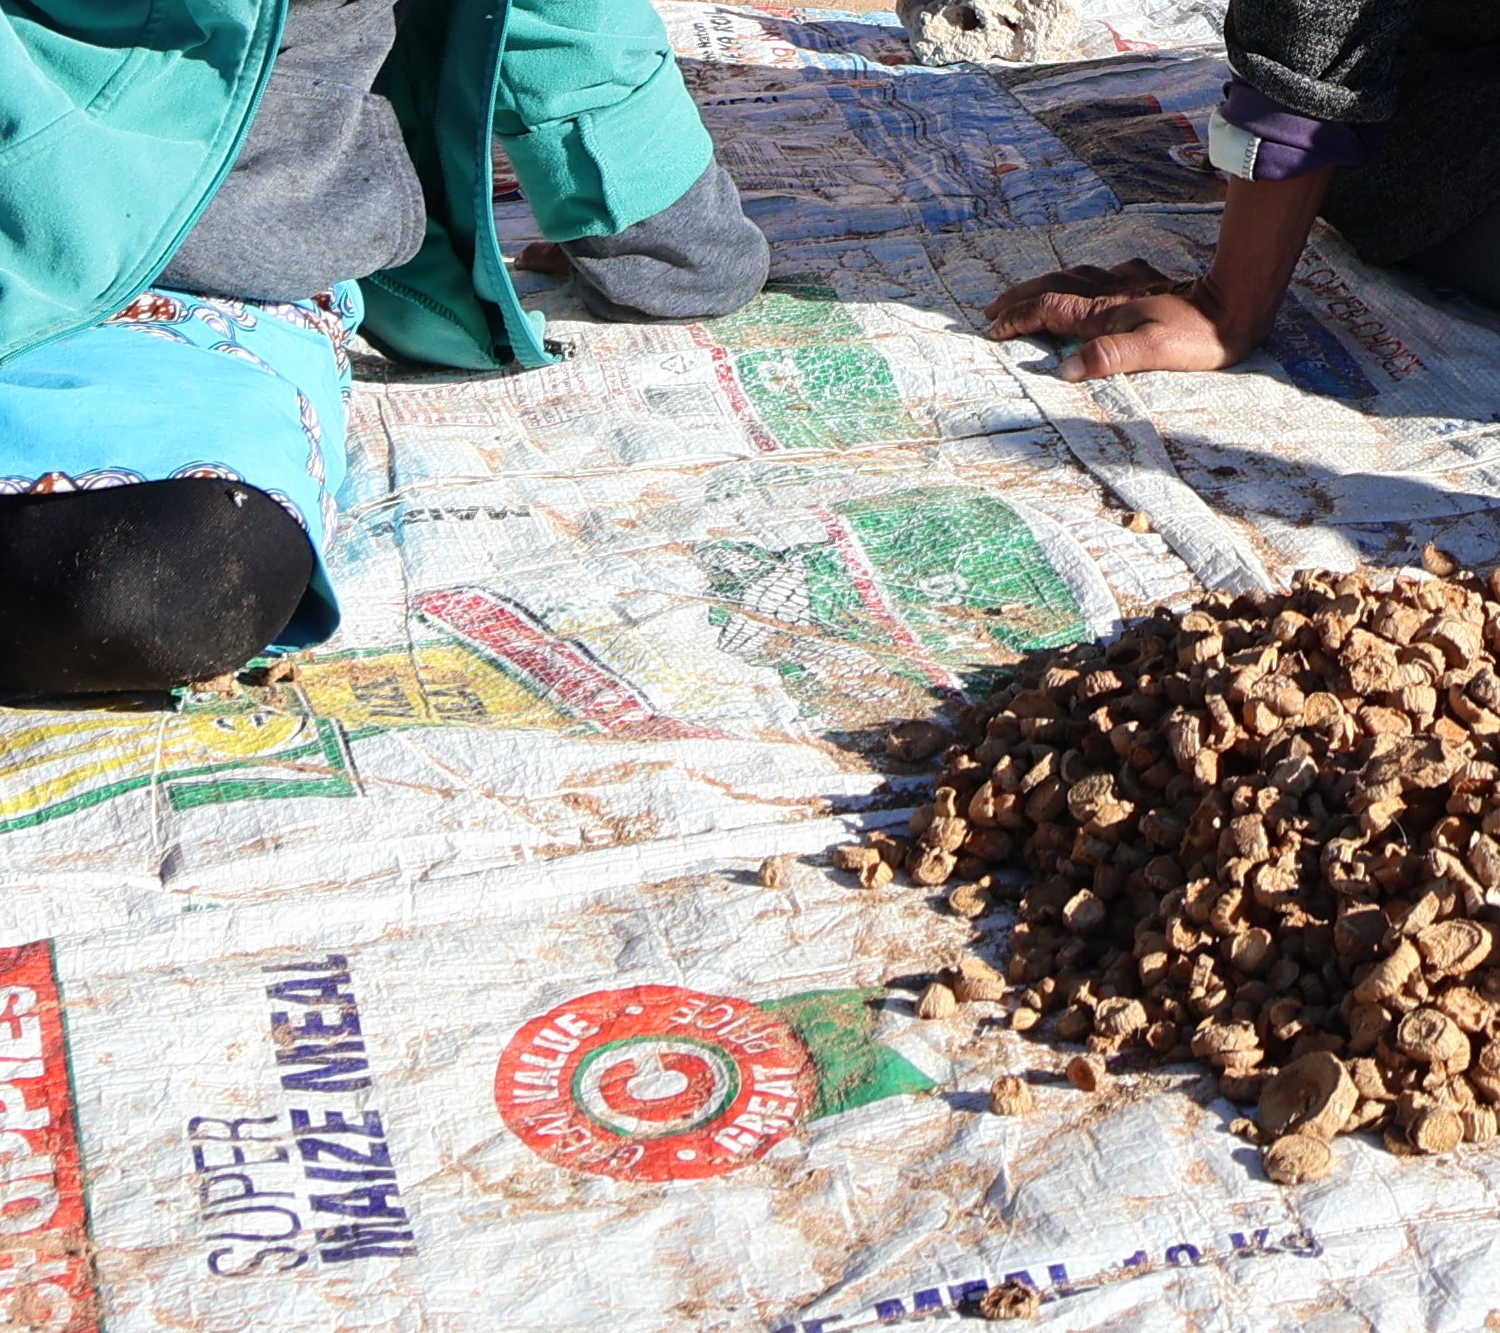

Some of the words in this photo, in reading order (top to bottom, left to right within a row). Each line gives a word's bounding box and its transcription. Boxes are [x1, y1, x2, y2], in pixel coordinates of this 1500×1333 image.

[264, 953, 373, 1093] MEAL
[512, 1013, 600, 1105] VALUE
[713, 1064, 799, 1154] GREAT
[187, 1114, 304, 1277] SUPER
[292, 1108, 415, 1264] MAIZE
